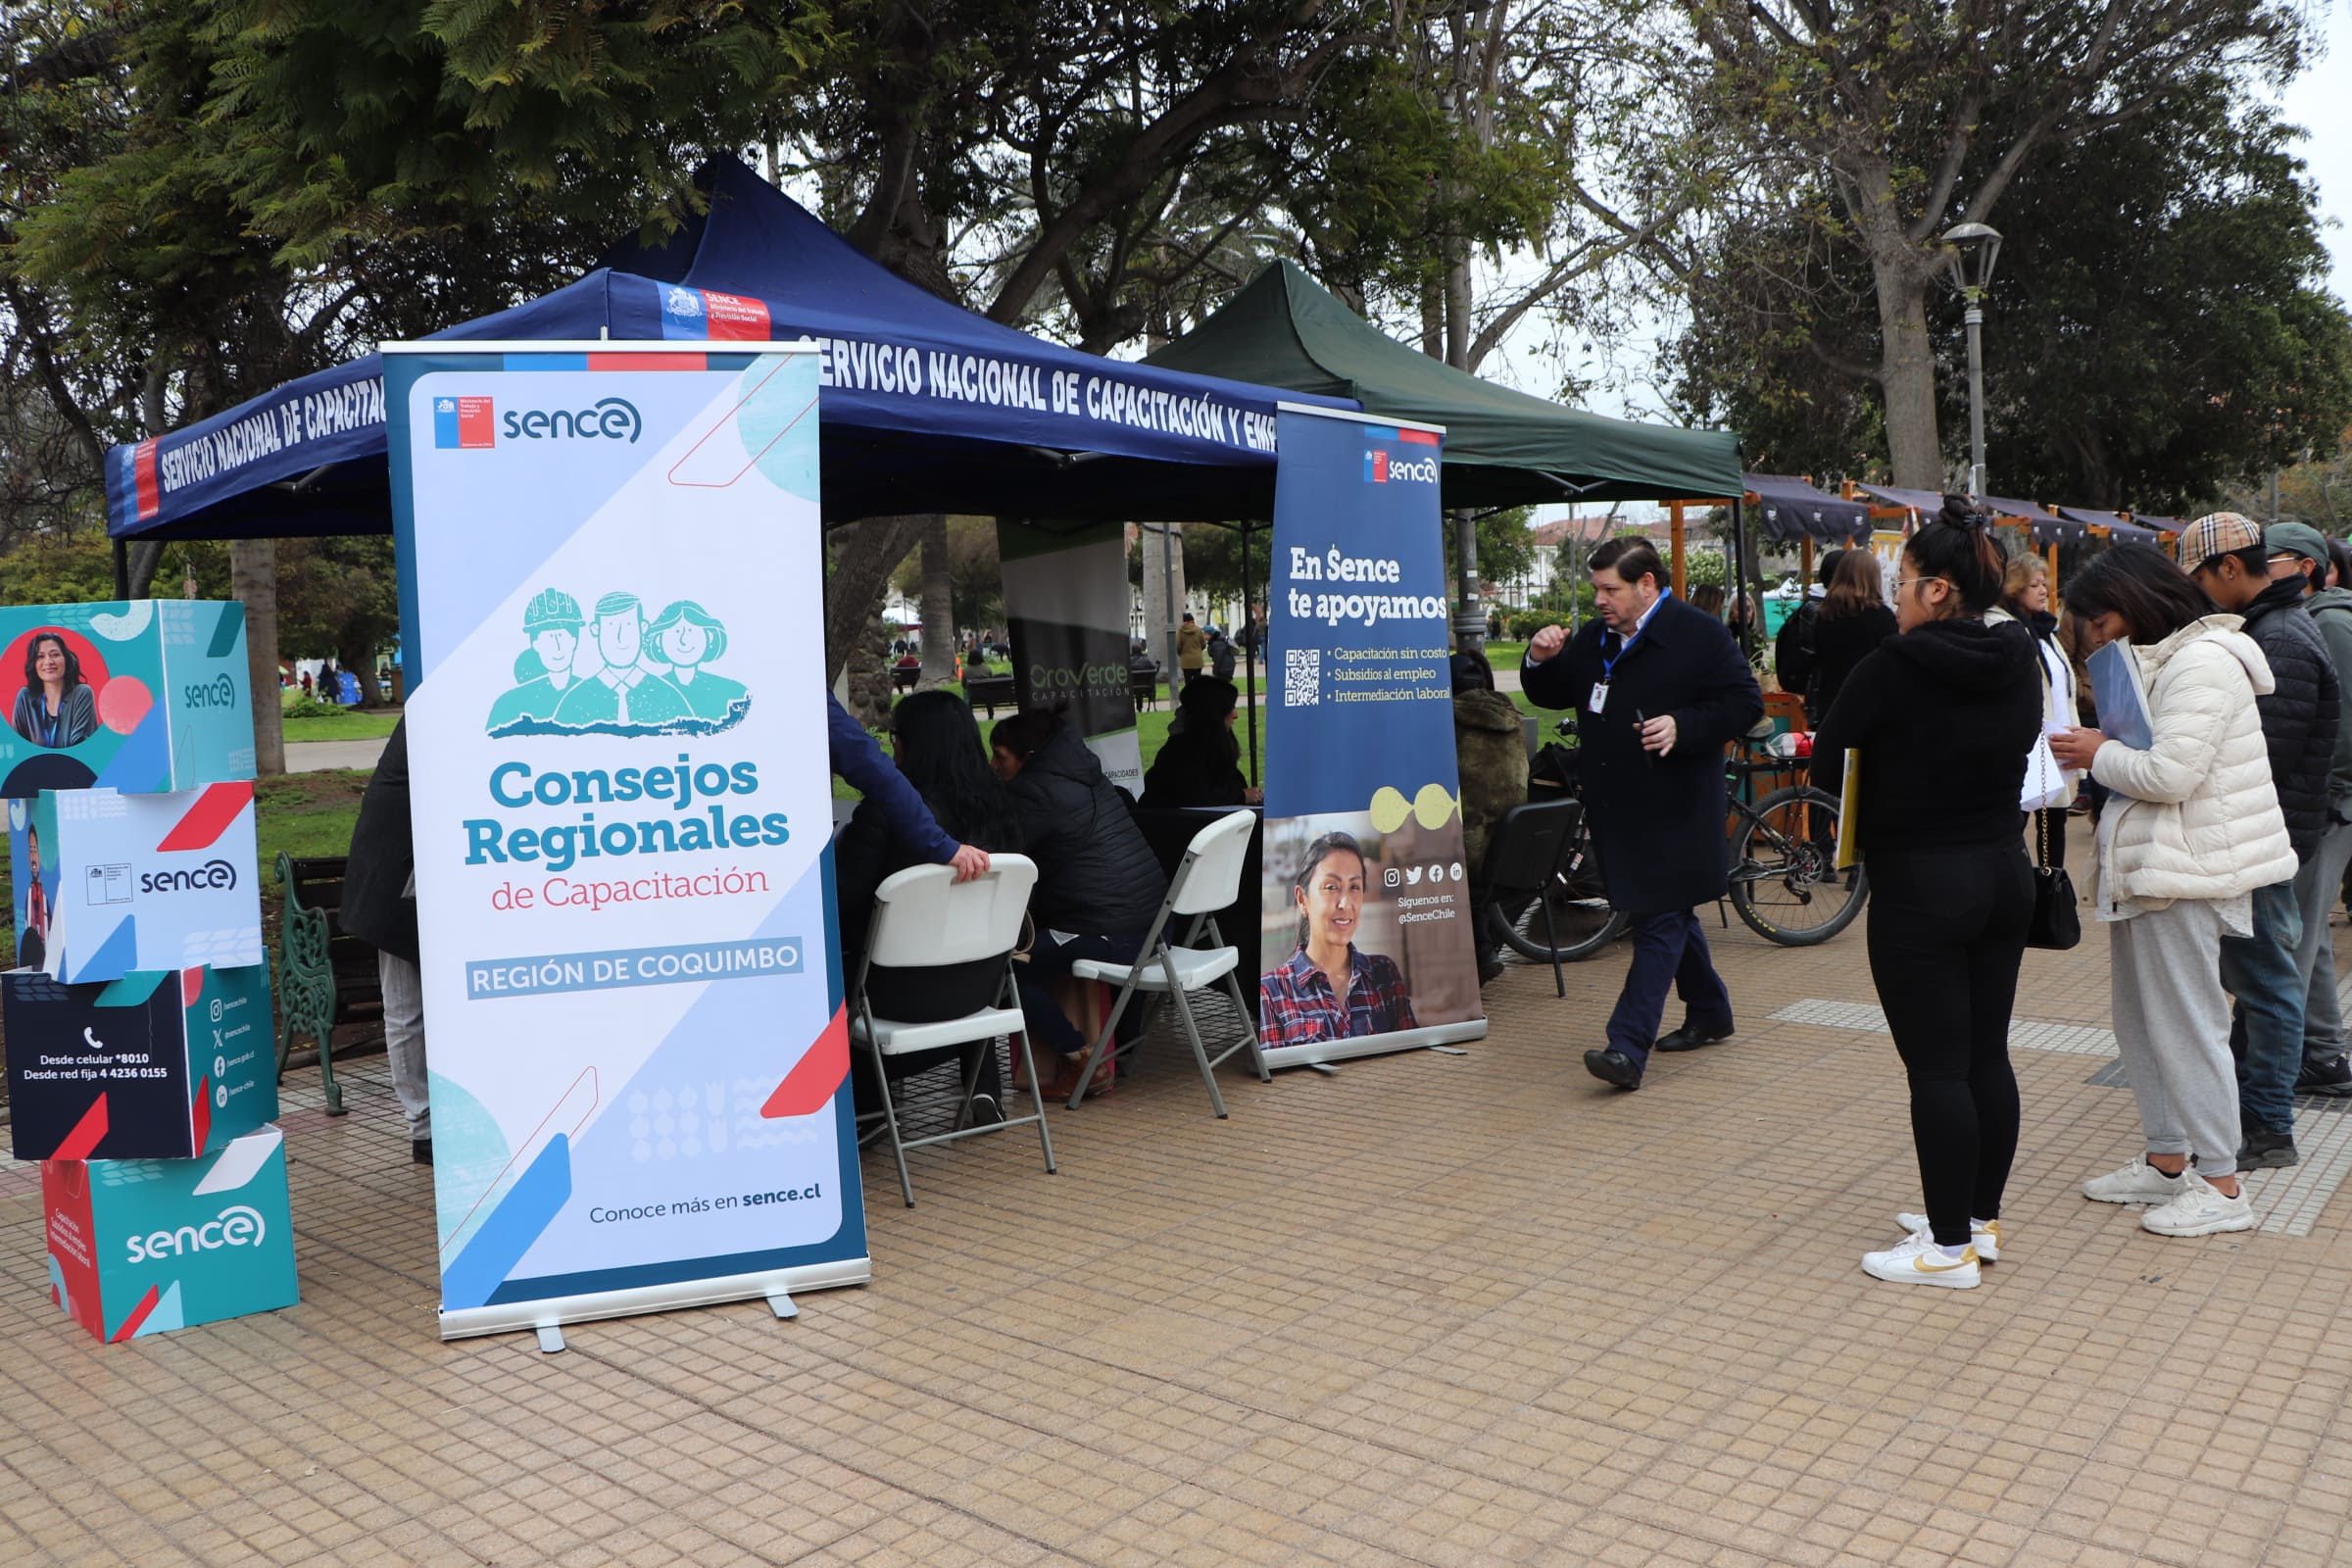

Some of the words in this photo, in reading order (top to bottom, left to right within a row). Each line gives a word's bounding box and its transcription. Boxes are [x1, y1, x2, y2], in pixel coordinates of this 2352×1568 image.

[705, 292, 742, 305] SENCE
[741, 314, 758, 322] Social
[799, 335, 921, 395] ERVICIO
[930, 351, 1047, 412] NACIONAL
[1052, 369, 1080, 416] DE
[1087, 377, 1226, 442] CAPACITACIÓN
[1228, 407, 1241, 446] Y
[504, 397, 642, 444] sence
[162, 440, 215, 493] SERVICIO
[213, 408, 282, 473] NACIONAL
[280, 399, 301, 445] DE
[1389, 457, 1438, 485] sence
[1290, 546, 1322, 580] En
[1289, 588, 1312, 618] te
[1315, 593, 1447, 627] apoyamos
[1334, 646, 1399, 662] Capacitación
[1400, 646, 1418, 660] sin
[1420, 648, 1447, 660] costo
[185, 672, 235, 710] sence
[1335, 666, 1383, 681] Subsidios
[1383, 667, 1392, 680] al
[1394, 666, 1436, 682] empleo
[1335, 688, 1414, 703] Intermediación
[1415, 686, 1450, 700] laboral
[490, 753, 759, 809] Consejos
[463, 806, 790, 871] Regionales
[141, 859, 237, 893] sence
[492, 881, 534, 910] de
[543, 864, 769, 911] Capacitación
[1397, 896, 1440, 909] Síguenos
[1441, 894, 1454, 904] en:
[1398, 908, 1455, 924] @SenceChile
[472, 957, 585, 992] REGIÓN
[593, 956, 629, 981] DE
[637, 945, 799, 978] COQUIMBO
[24, 1069, 58, 1080] Desde
[61, 1069, 78, 1080] red
[80, 1068, 98, 1081] fija
[99, 1068, 108, 1078] 4
[110, 1067, 138, 1079] 4236
[140, 1067, 168, 1078] 0155
[40, 1054, 74, 1065] Desde
[76, 1054, 114, 1065] celular
[589, 1201, 667, 1224] Conoce
[672, 1195, 710, 1215] más
[715, 1196, 739, 1210] en
[742, 1183, 821, 1207] sence.cl
[126, 1205, 266, 1264] sence
